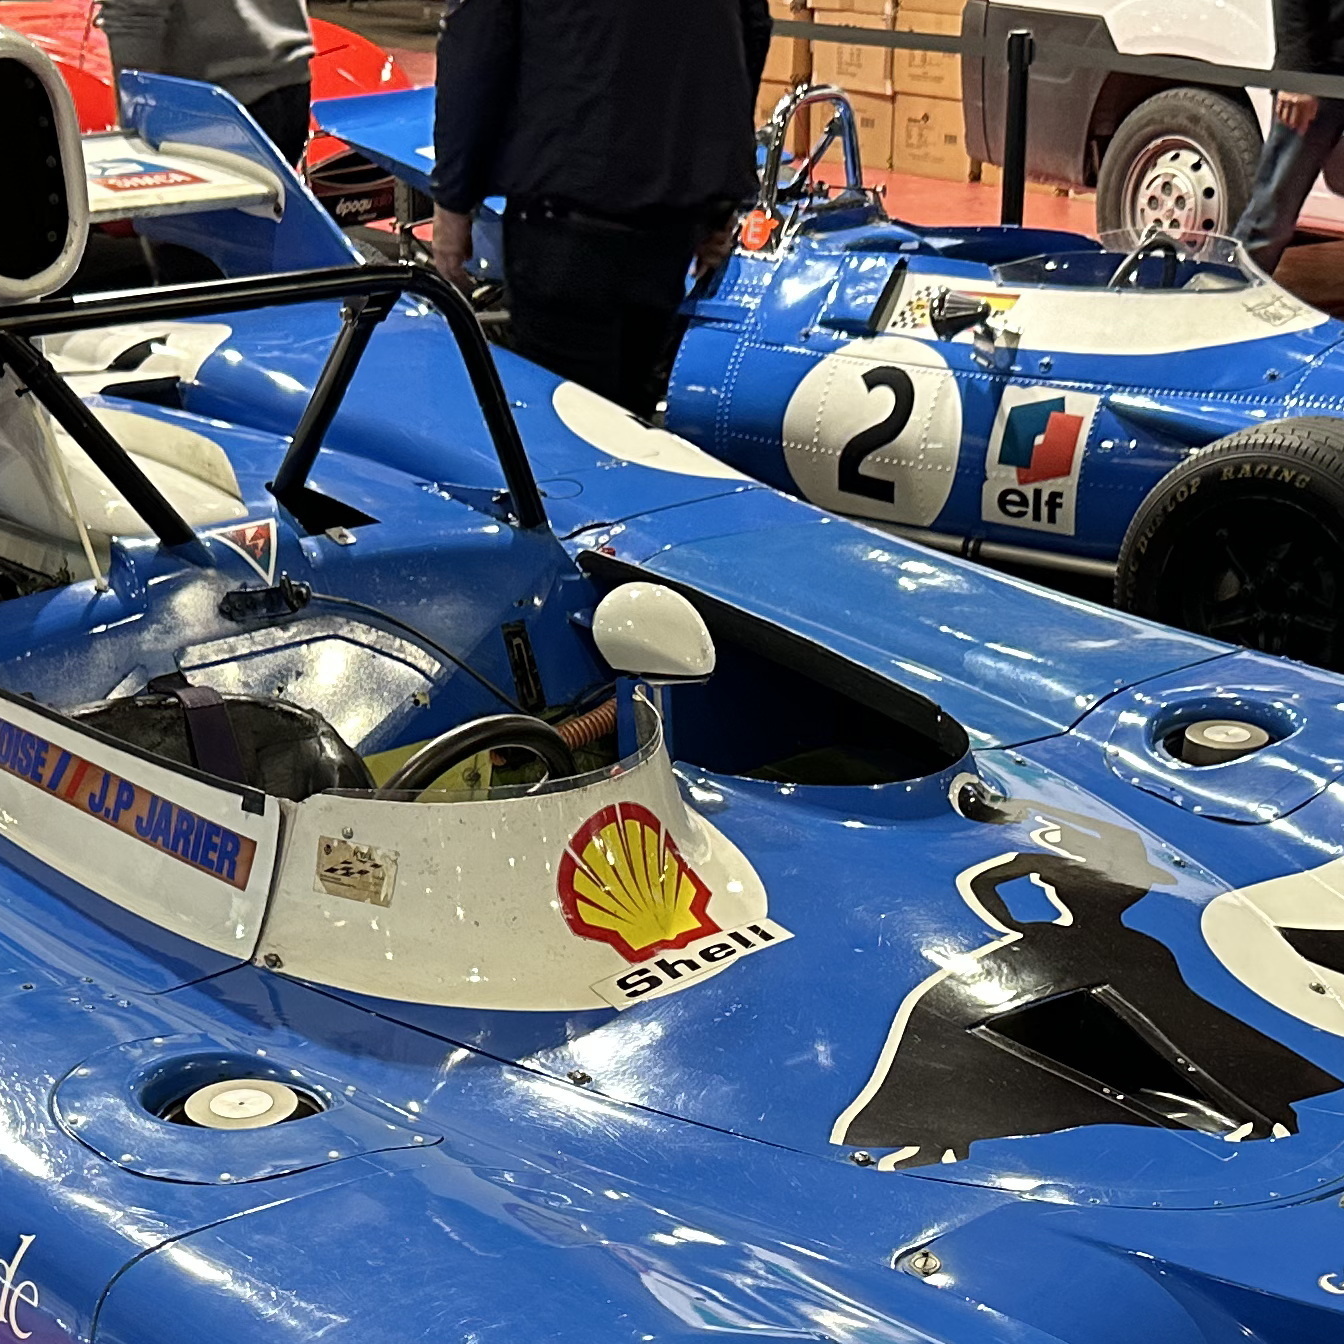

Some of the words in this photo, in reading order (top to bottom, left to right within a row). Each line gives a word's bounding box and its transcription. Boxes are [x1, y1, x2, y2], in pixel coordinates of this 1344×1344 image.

[838, 365, 915, 505] 2
[997, 487, 1064, 525] elf
[1137, 476, 1202, 555] DUNLOP
[1219, 463, 1311, 489] RACING
[134, 795, 242, 881] JARIER
[616, 924, 776, 998] Shell
